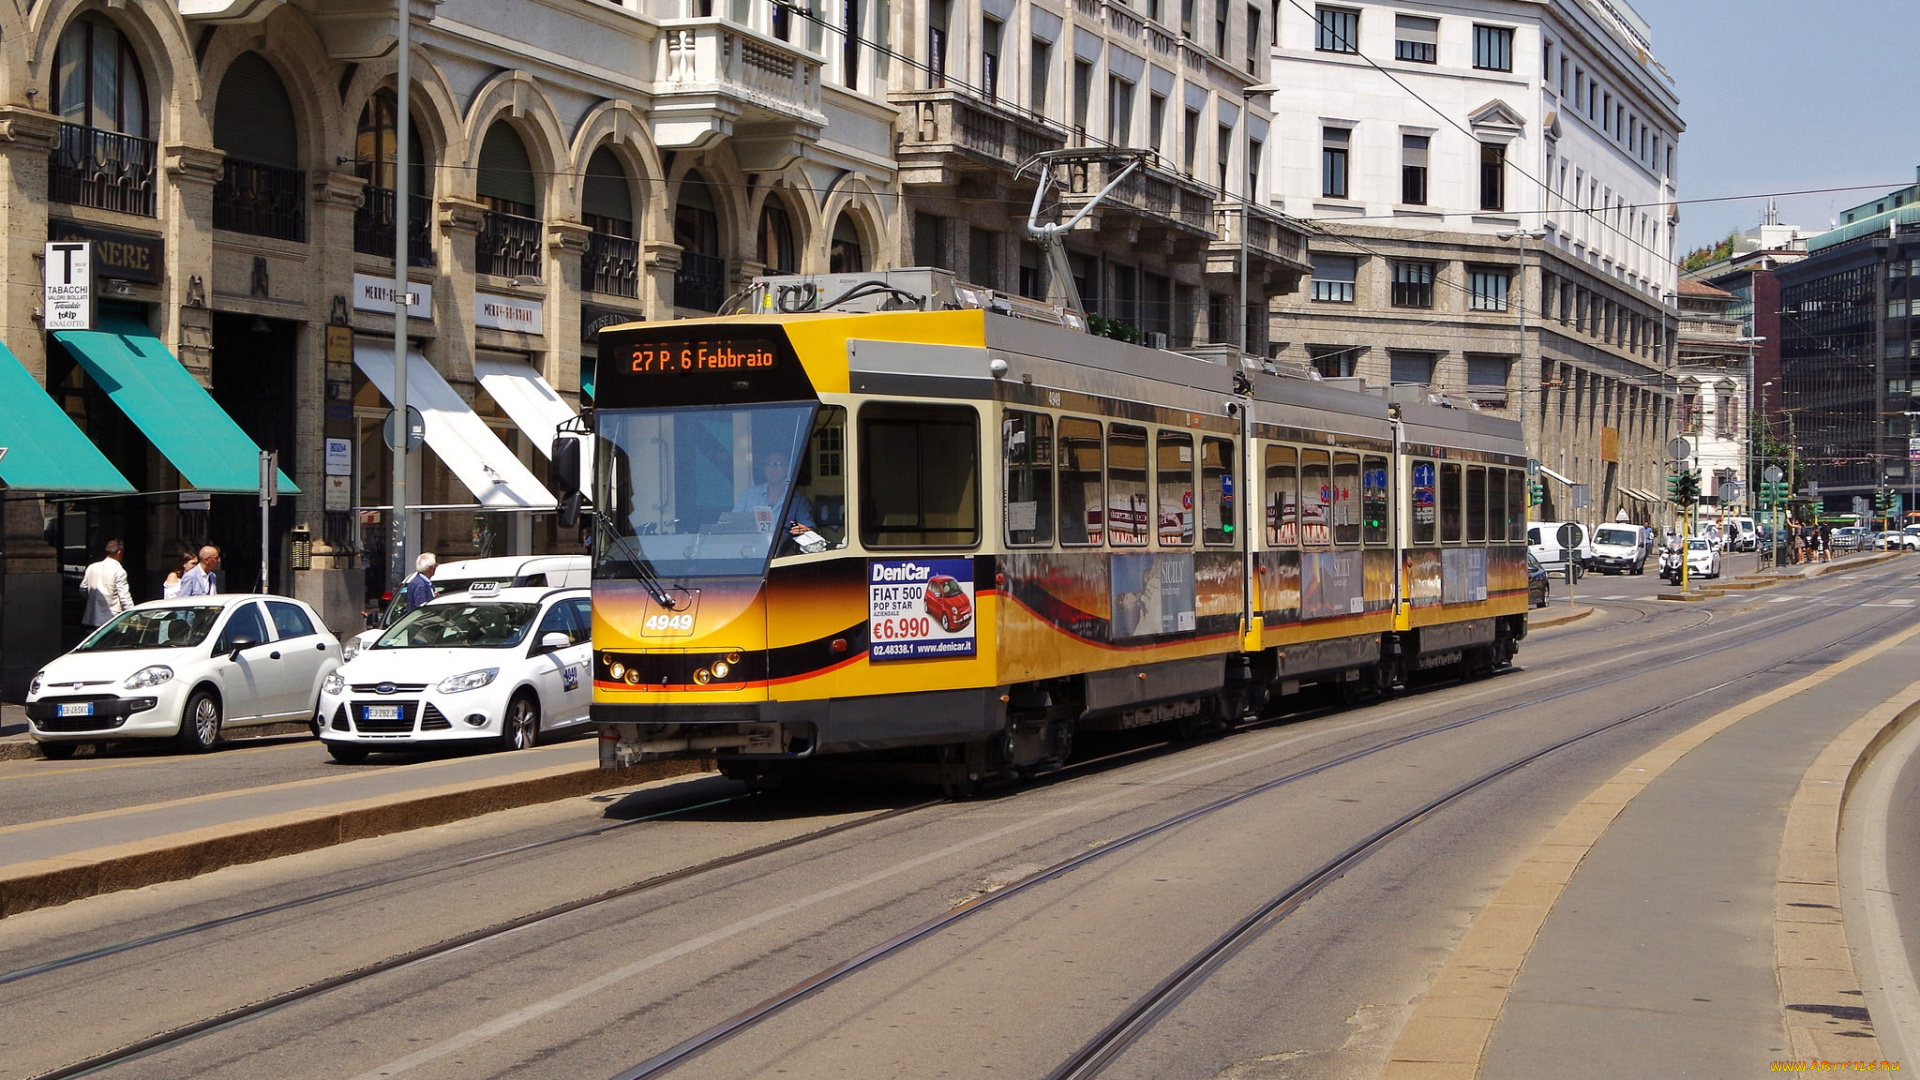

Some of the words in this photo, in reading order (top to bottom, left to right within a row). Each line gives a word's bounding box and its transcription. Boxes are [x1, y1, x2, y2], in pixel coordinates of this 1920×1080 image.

[52, 244, 83, 285] T
[48, 286, 88, 294] TABACCHI
[58, 310, 77, 319] totip
[632, 351, 653, 371] 27
[660, 350, 675, 370] P.
[681, 349, 692, 369] 6
[698, 348, 772, 369] Febbraio
[760, 522, 771, 532] 27
[872, 562, 930, 582] DeniCar
[1162, 561, 1184, 583] SICILY
[873, 587, 899, 601] FIAT
[902, 586, 922, 600] 500
[873, 602, 890, 611] POP
[892, 601, 913, 610] STAR
[645, 614, 693, 630] 4949
[873, 644, 914, 656] 02.48338.1
[917, 641, 972, 653] www.denicar.it
